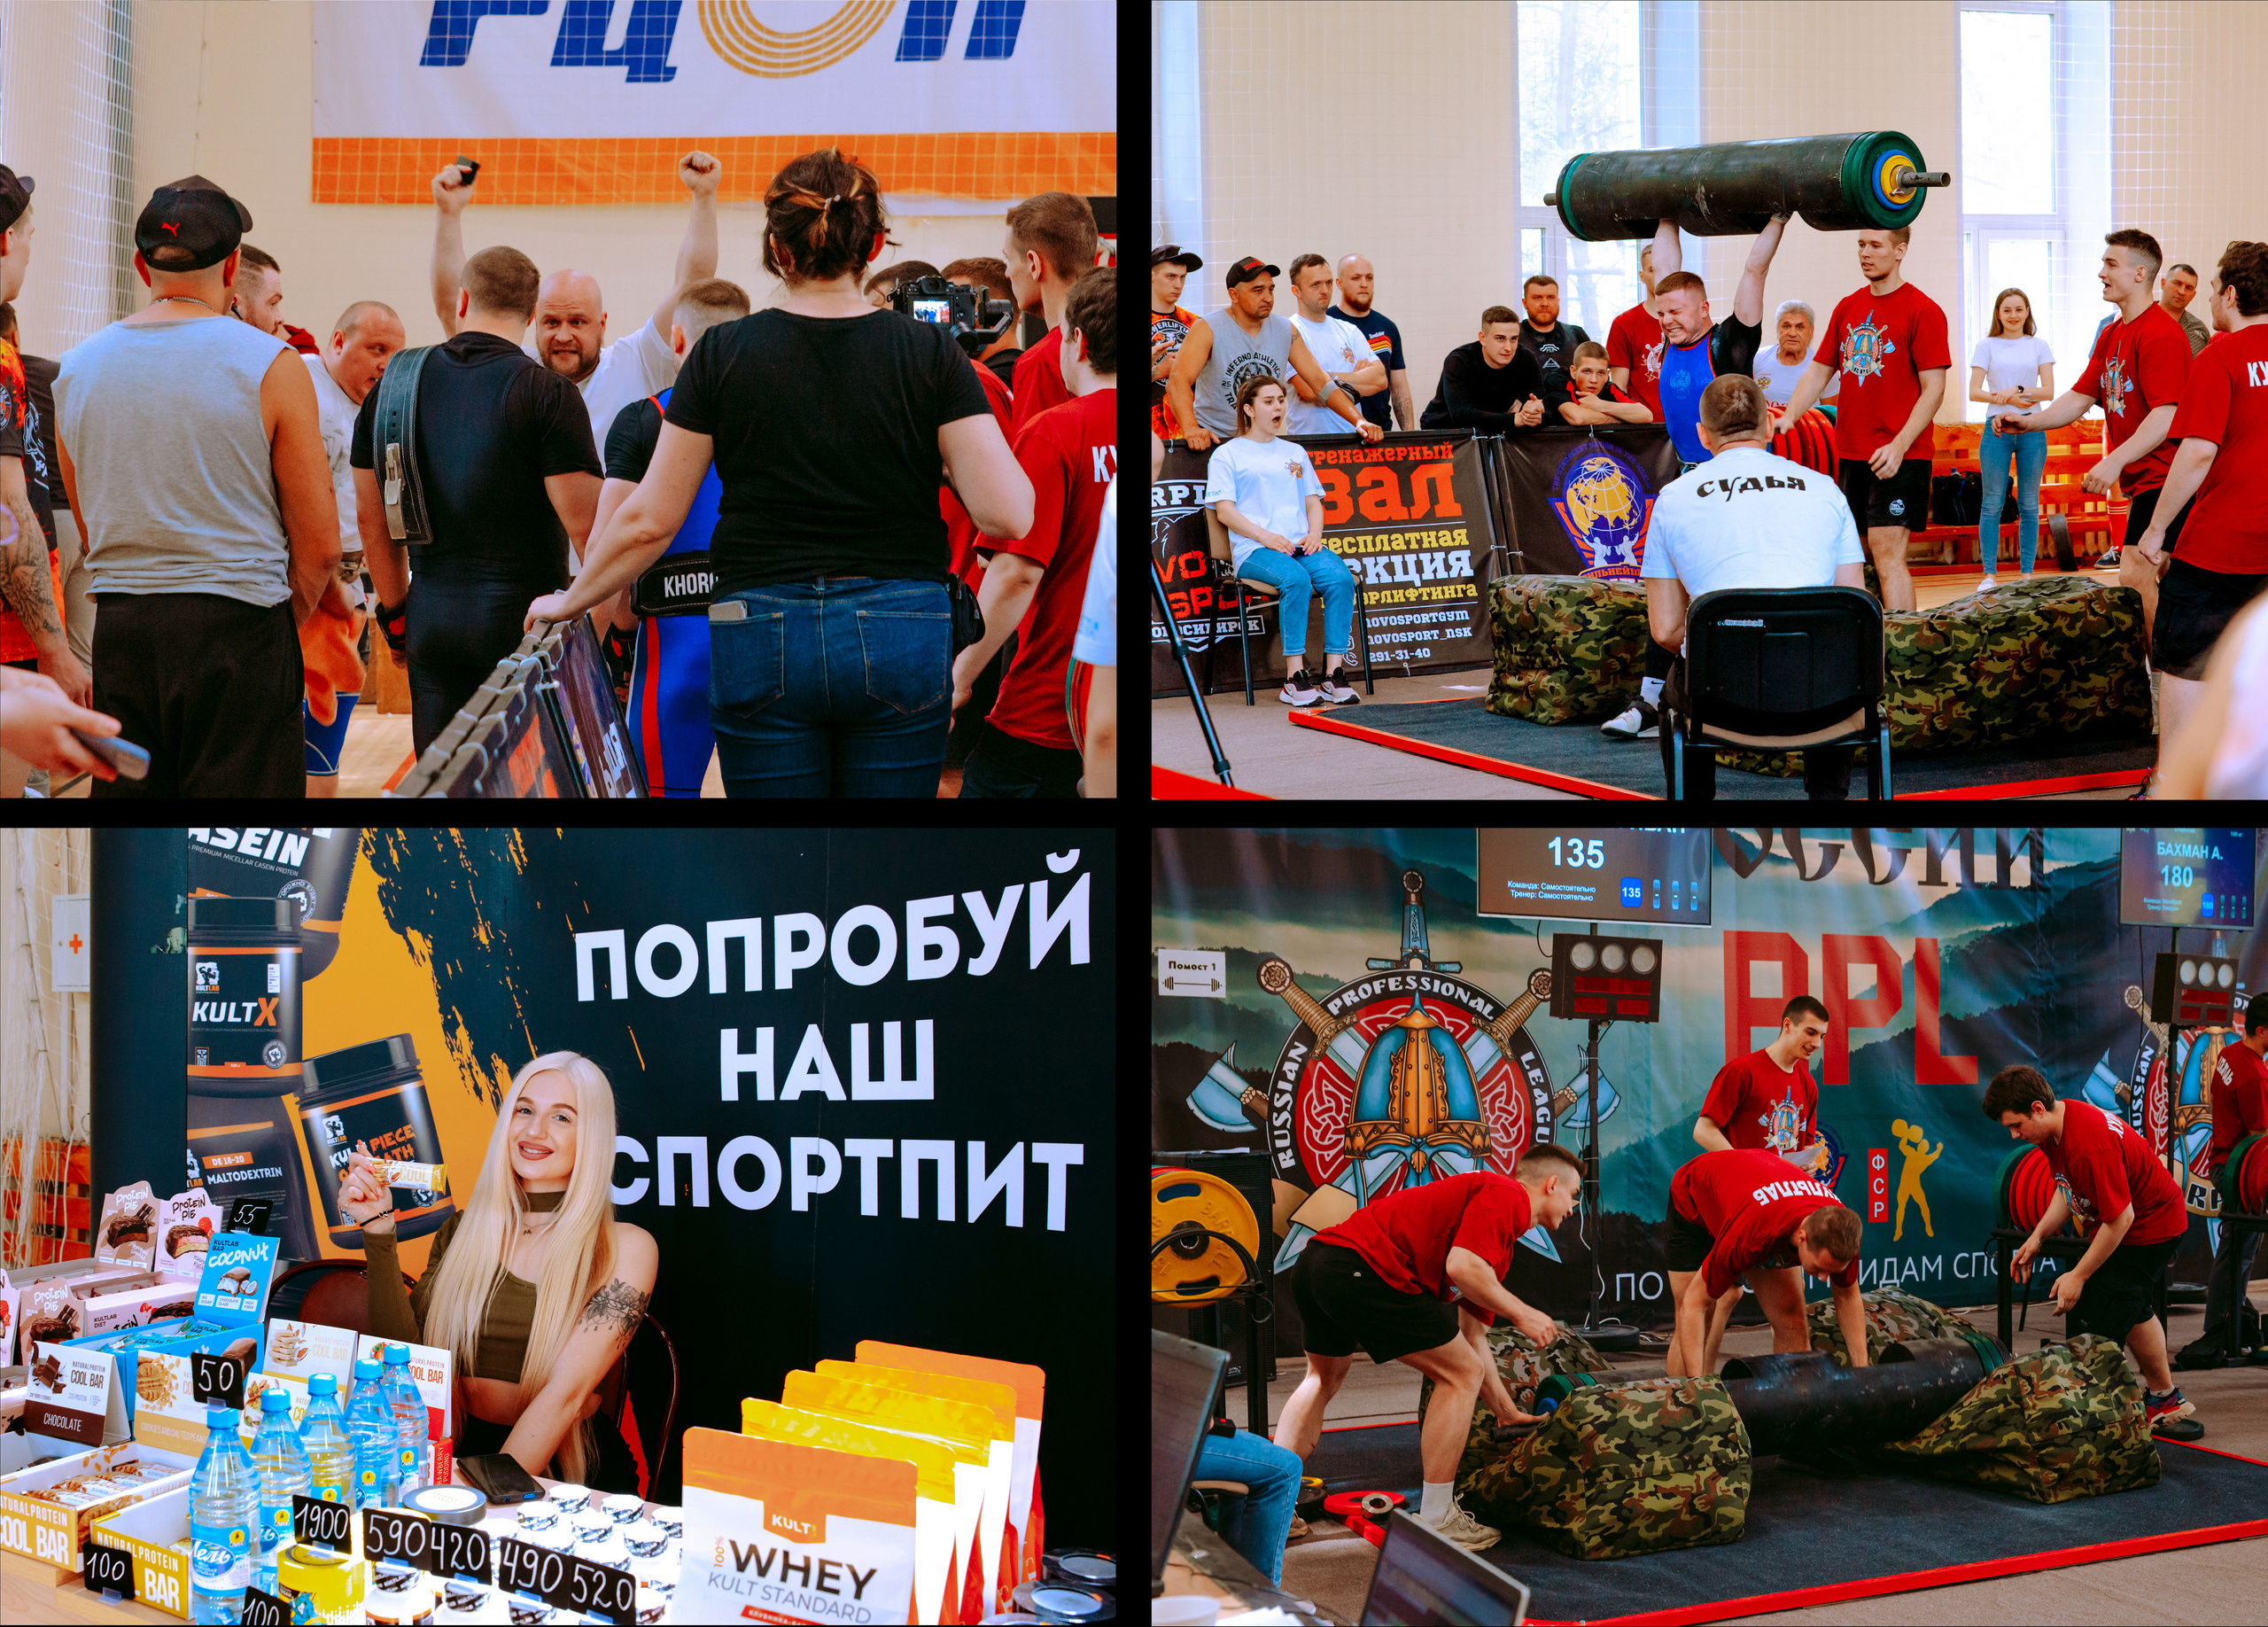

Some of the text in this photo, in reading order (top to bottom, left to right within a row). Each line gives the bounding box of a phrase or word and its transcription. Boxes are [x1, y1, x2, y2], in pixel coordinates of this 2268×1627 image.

[1225, 353, 1252, 377] INFERNO
[1342, 549, 1474, 588] екция
[664, 572, 718, 598] KHOR
[191, 844, 299, 877] PREMIUM MICELLAR CASEIN PROTEIN
[1548, 836, 1605, 869] 135
[2156, 841, 2209, 860] БАХМАН
[1507, 880, 1596, 893] Команда: Самостоятельно
[2161, 864, 2194, 888] 180
[1511, 890, 1594, 902] Тренер: Самостоятельно
[1622, 887, 1642, 899] 135
[575, 848, 1091, 1002] ПОПРОБУЙ
[1168, 960, 1216, 972] Помост 1
[1327, 975, 1496, 1021] PROFESSIONAL
[719, 1018, 936, 1102] НАШ
[1272, 1040, 1309, 1170] RUSSIAN
[1519, 1050, 1551, 1145] LEAGU
[2132, 1045, 2155, 1138] USSIAN
[369, 1124, 416, 1153] PIECE
[212, 1155, 245, 1166] DE 18-20
[400, 1164, 429, 1183] COOL
[206, 1167, 284, 1186] MALTODEXTRIN
[610, 1134, 1084, 1232] СПОРТПИТ
[234, 1204, 268, 1225] 55
[1615, 1271, 1664, 1302] ПО
[1858, 1254, 1943, 1287] ИДАМ
[94, 1313, 117, 1323] KULTLAB
[313, 1343, 348, 1361] COOL BAR
[409, 1357, 445, 1369] ATURAL PROTEIN
[71, 1369, 105, 1389] COOL BAR
[73, 1361, 105, 1373] NATURAL PROTEIN
[198, 1358, 235, 1392] 50
[427, 1368, 444, 1384] BAR
[183, 1380, 193, 1396] CO
[43, 1413, 82, 1432] CHOCOLATE
[293, 1405, 306, 1422] CO
[190, 1431, 208, 1444] PEANU
[30, 1505, 67, 1527] PROTEIN
[294, 1503, 349, 1540] 1900
[772, 1514, 811, 1535] KULT
[36, 1524, 69, 1566] BAR
[366, 1514, 426, 1557] 590
[431, 1527, 485, 1571] 420
[137, 1545, 179, 1573] PROTEIN
[713, 1536, 725, 1569] 100%
[87, 1552, 126, 1581] 100
[502, 1541, 563, 1593] 490
[728, 1538, 878, 1601] WHEY
[144, 1567, 181, 1612] BAR
[571, 1562, 634, 1612] 520
[708, 1571, 872, 1624] KULT STANDARD
[244, 1598, 280, 1625] 100
